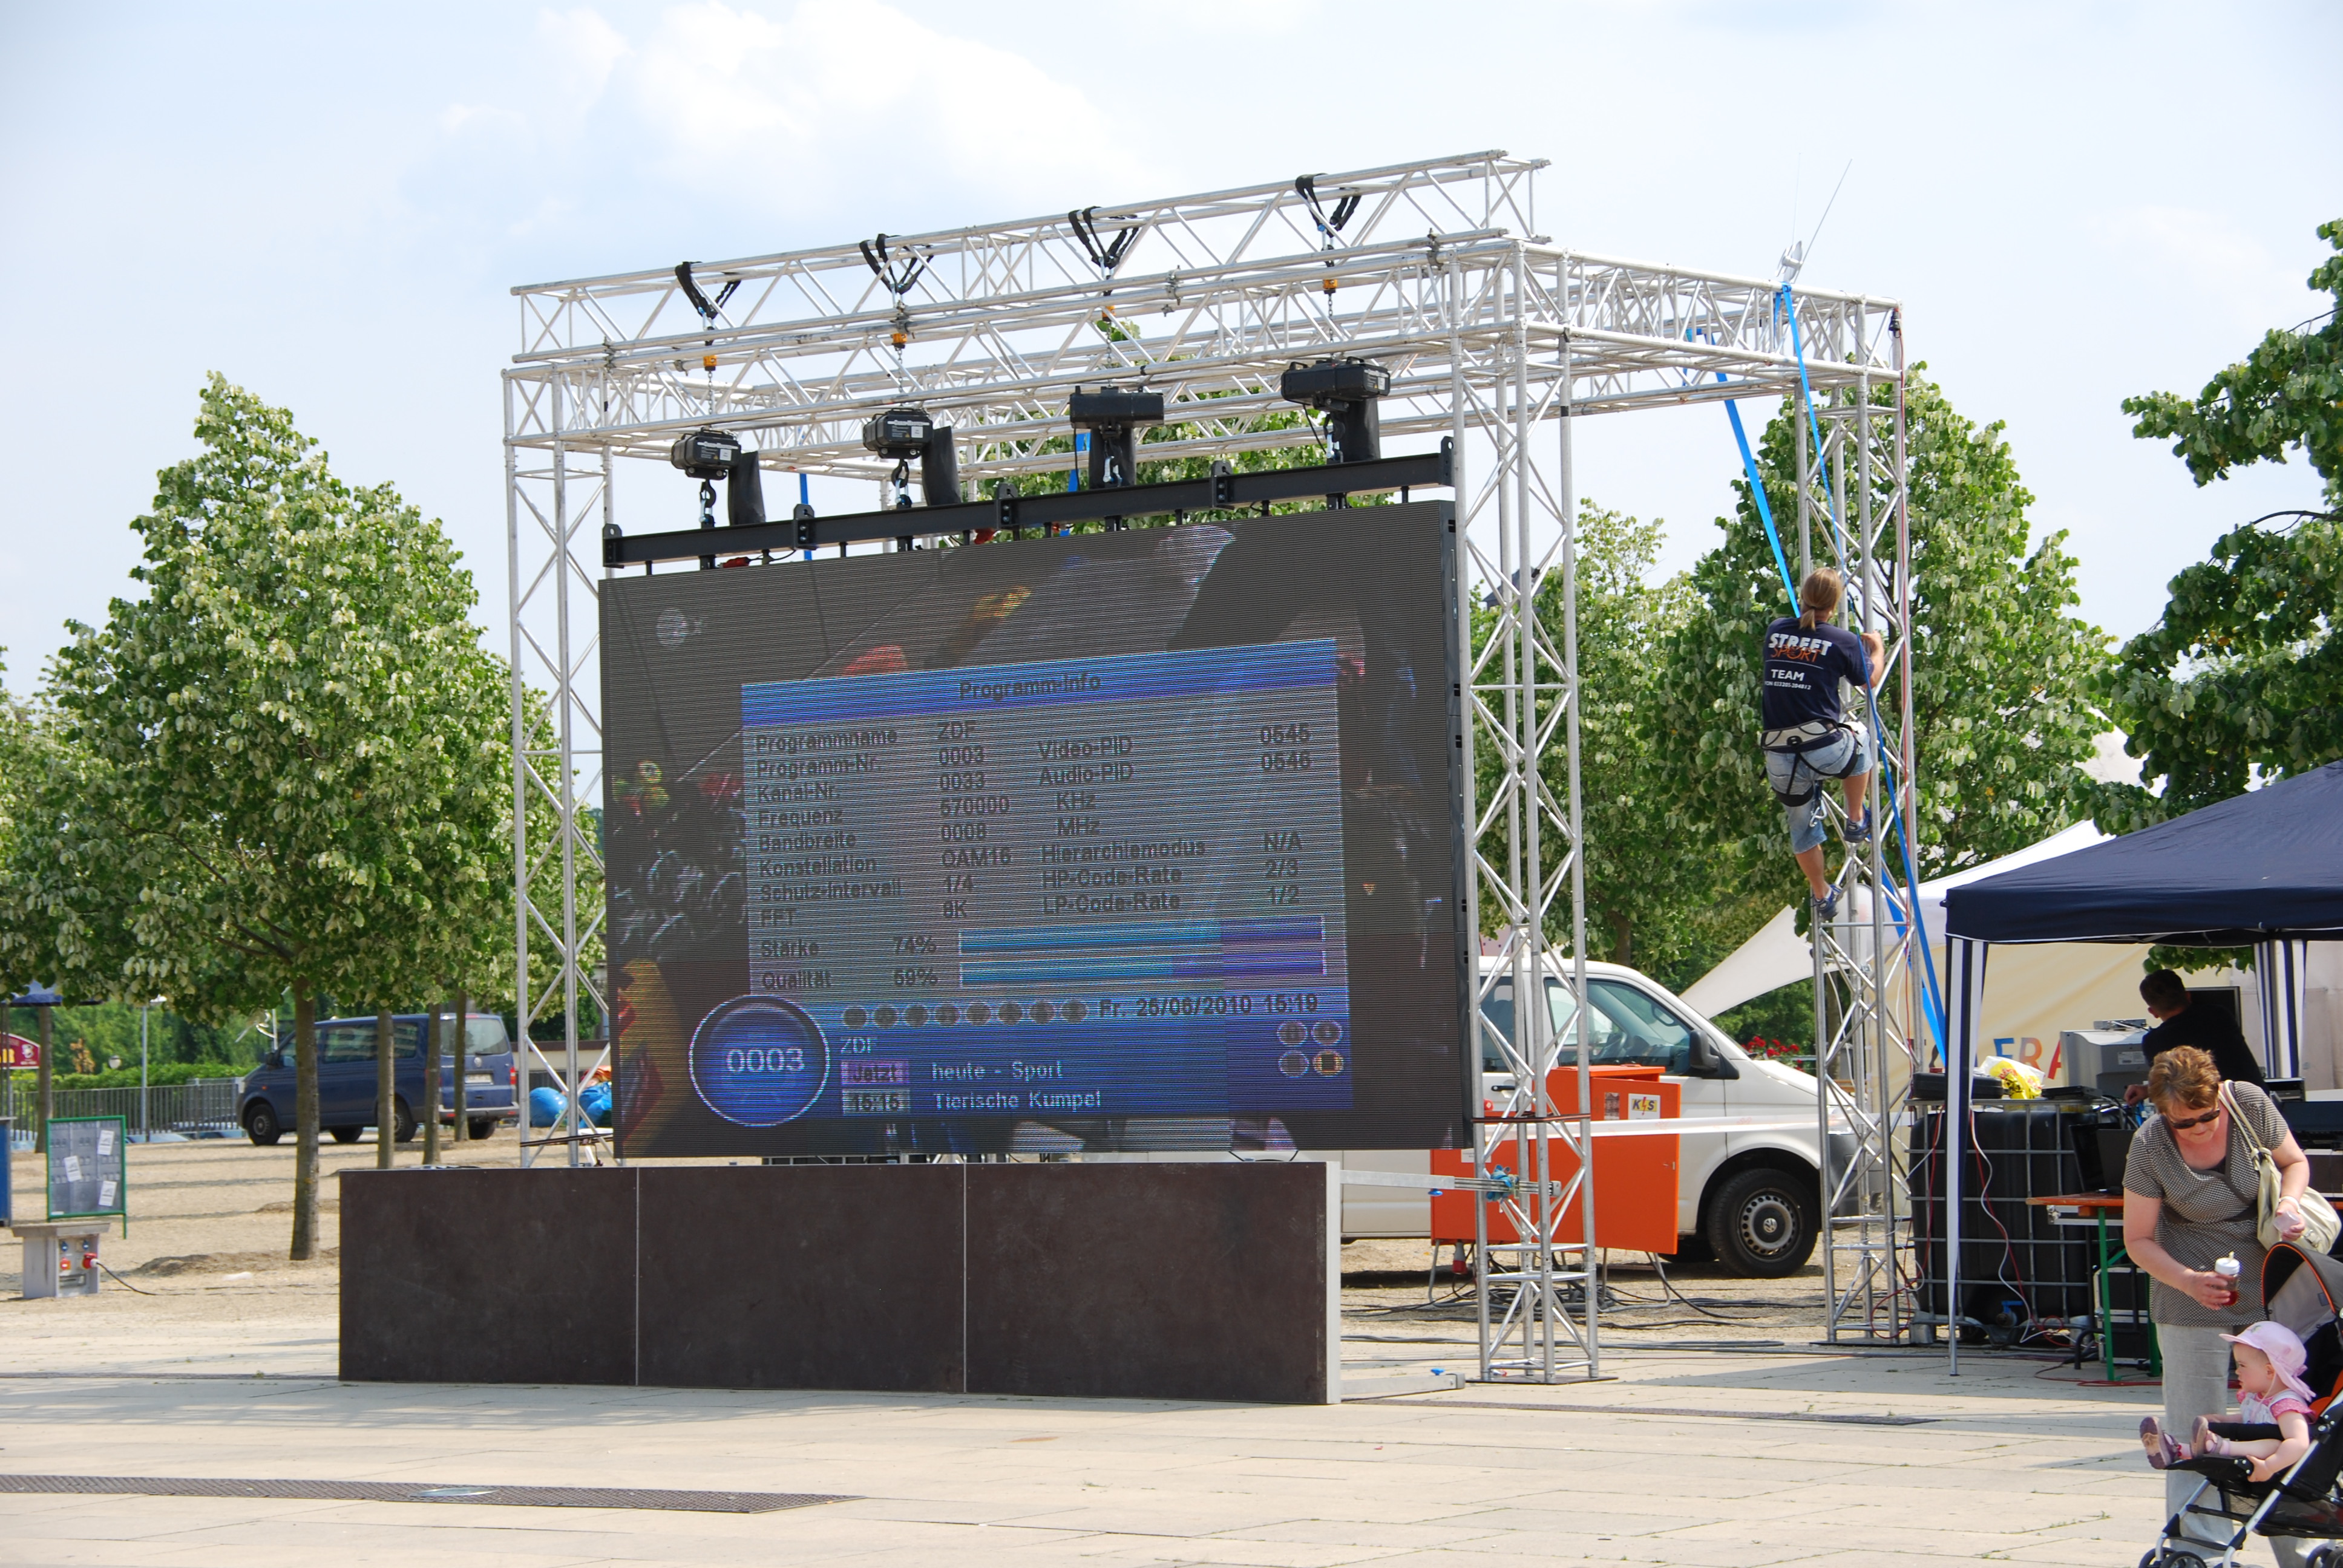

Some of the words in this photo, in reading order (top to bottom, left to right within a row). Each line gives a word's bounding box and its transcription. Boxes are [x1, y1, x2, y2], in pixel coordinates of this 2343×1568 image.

[1768, 633, 1832, 656] STREET
[1771, 644, 1821, 662] SPORT
[960, 672, 1101, 701] Programm-Info
[1771, 669, 1804, 681] TEAM
[756, 730, 897, 754] Programmname
[937, 720, 976, 742] ZDF
[1037, 736, 1132, 760] Video-PID
[939, 745, 985, 767] 0003
[940, 771, 985, 792] 0033
[1039, 762, 1134, 787] Audio-PID
[758, 808, 842, 829] Frequenz
[1057, 792, 1095, 811] KHz
[759, 830, 856, 853] Bandbreite
[941, 822, 987, 842] 0008
[1057, 817, 1100, 837] MHz
[1041, 838, 1205, 864] Hierarchiemodus
[1263, 830, 1302, 852] N/A
[760, 855, 876, 877] Konstellation
[942, 846, 1011, 868] QAM16
[1042, 864, 1182, 889] HP-Code-Rate
[1265, 857, 1299, 878] 2/3
[945, 873, 973, 894] 1/4
[1043, 891, 1180, 915] LP-Code-Rate
[1268, 884, 1299, 905] 1/2
[761, 908, 797, 927] FFT
[943, 900, 968, 918] 8K
[761, 938, 819, 959] Stärke
[893, 935, 936, 955] 74%
[762, 970, 830, 990] Qualität
[1099, 998, 1126, 1019] Fr.
[841, 1036, 877, 1055] ZDF
[727, 1046, 805, 1074] 0003
[932, 1060, 986, 1080] heute
[1012, 1059, 1063, 1082] Sport
[853, 1063, 897, 1083] Jetzt
[934, 1091, 1019, 1112] Tierische
[1029, 1090, 1101, 1113] Kumpel
